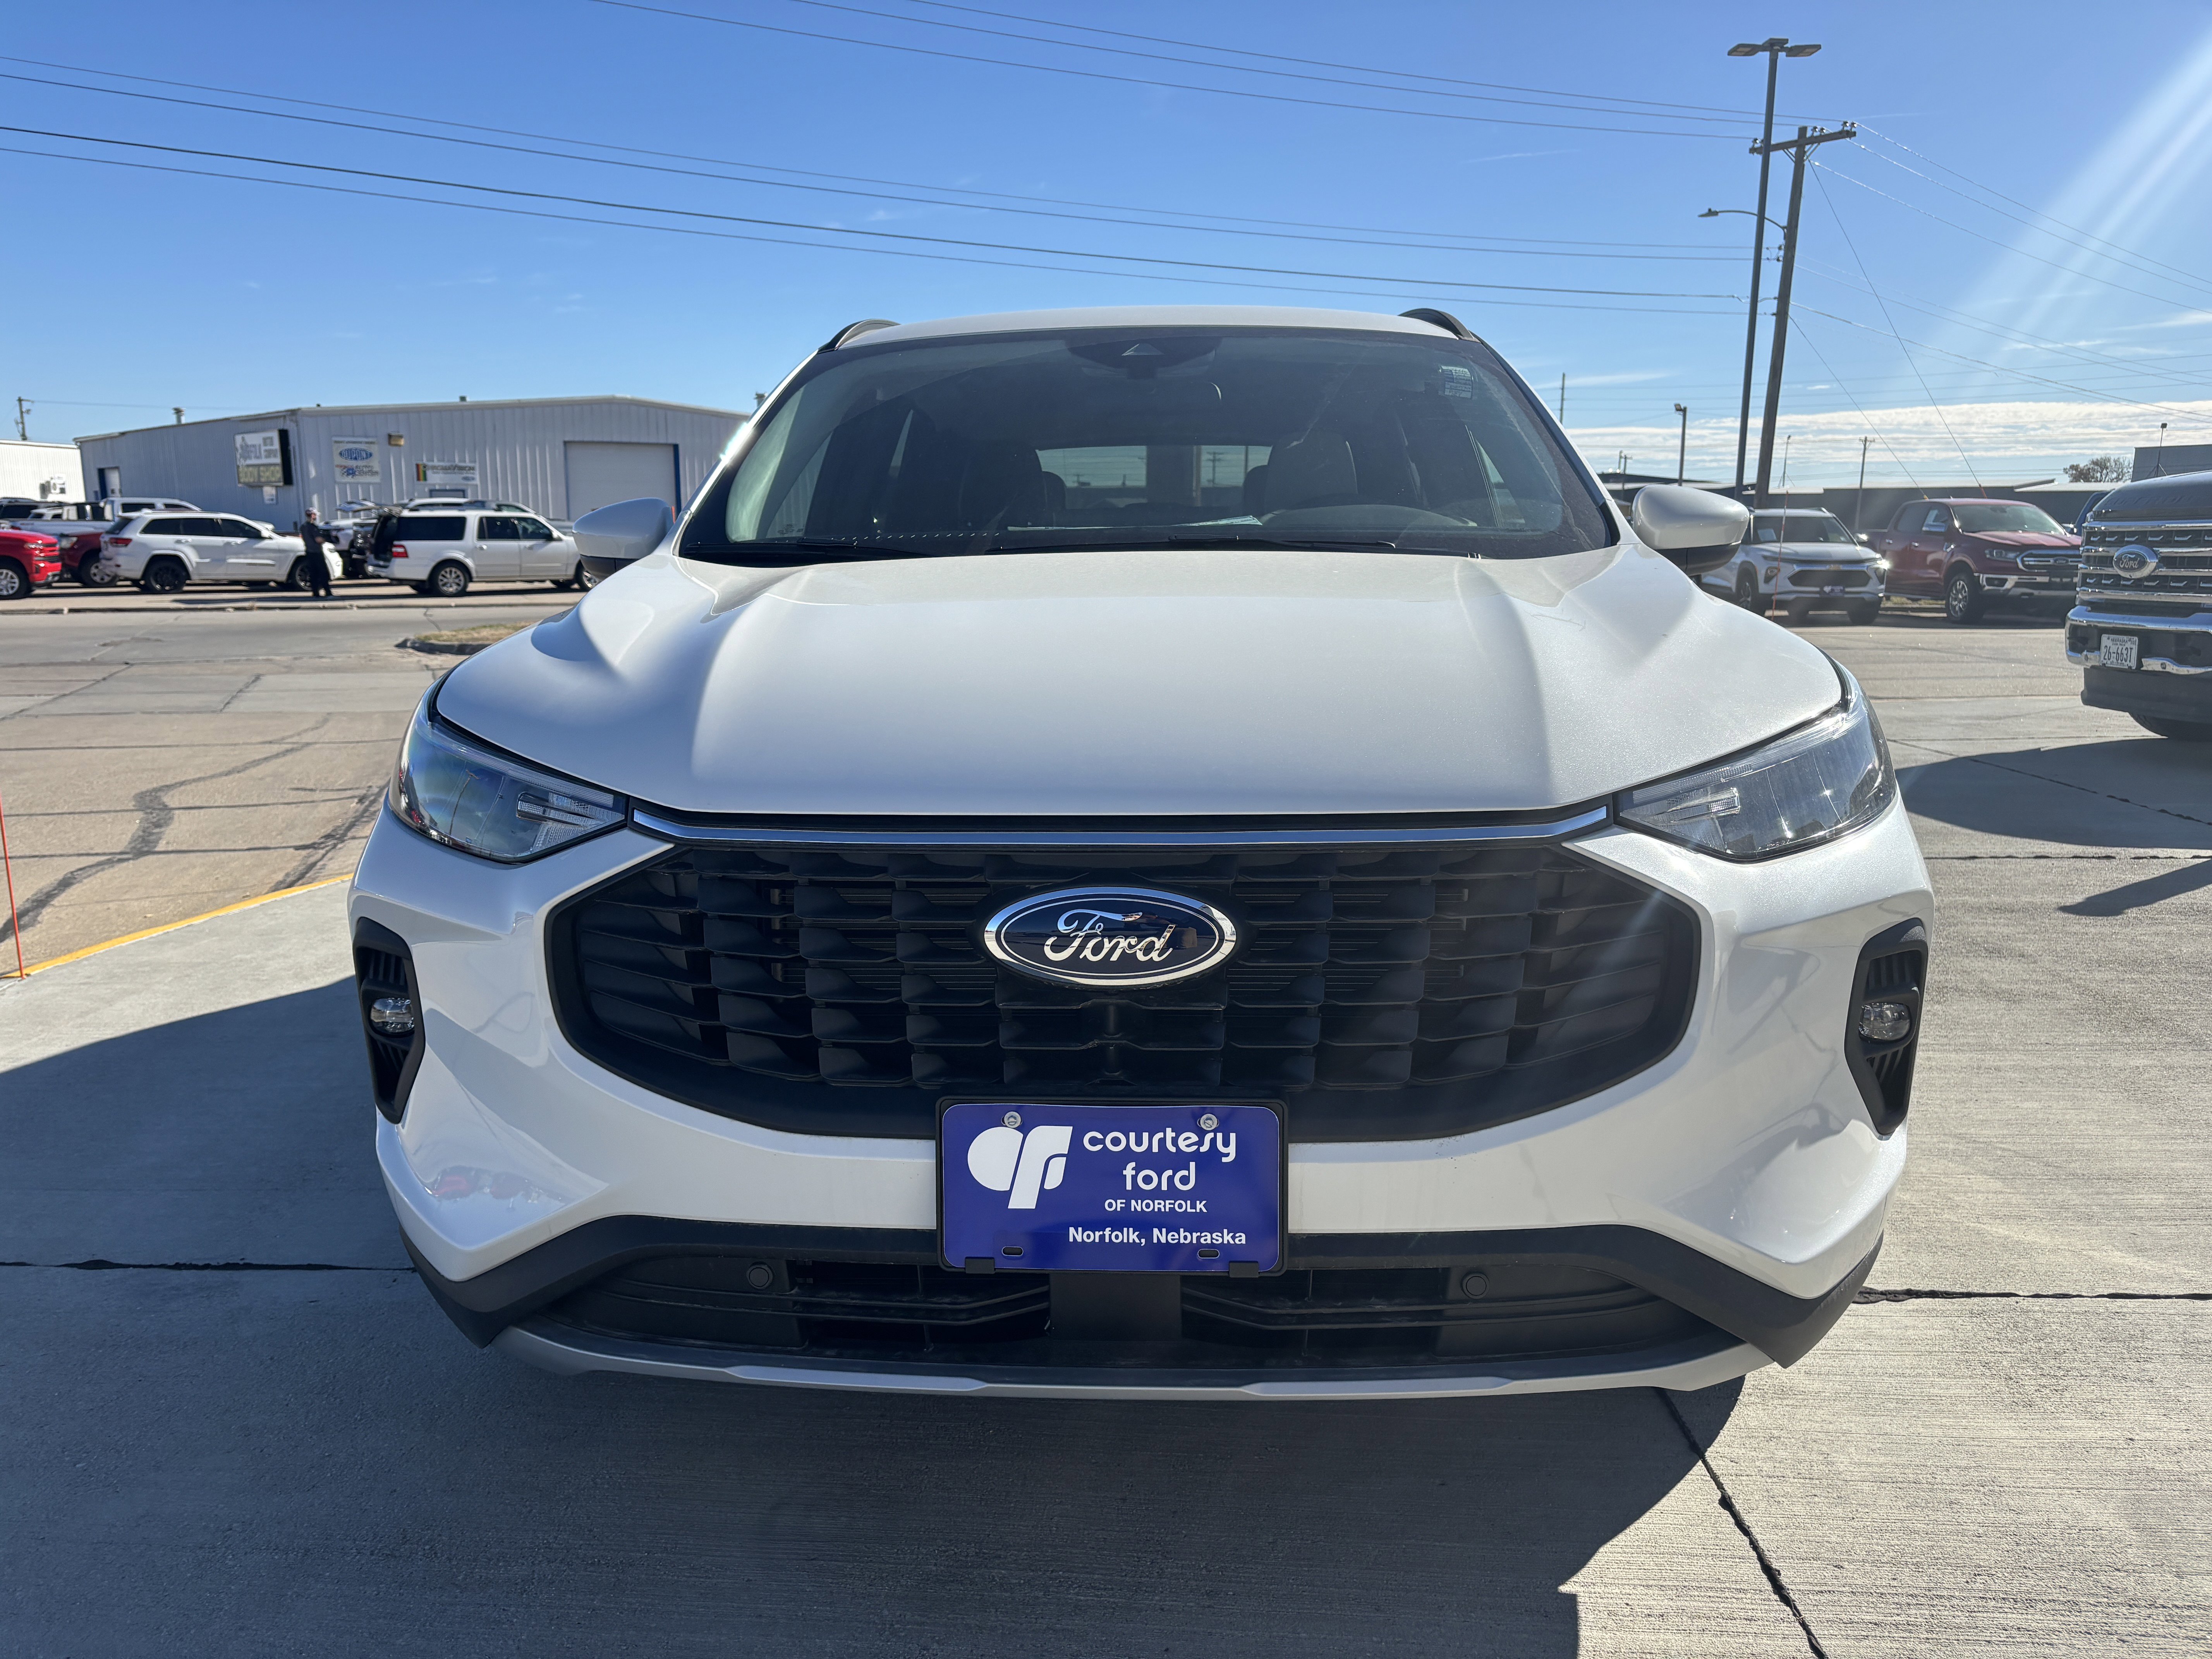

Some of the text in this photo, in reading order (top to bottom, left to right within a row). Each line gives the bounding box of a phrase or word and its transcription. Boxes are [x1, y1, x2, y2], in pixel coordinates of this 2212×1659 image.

[2119, 554, 2140, 568] Ford
[1044, 909, 1176, 962] Ford
[1084, 1127, 1235, 1163] courtesy
[1123, 1161, 1195, 1190] ford
[1105, 1199, 1207, 1212] OF NORFOLK
[1070, 1227, 1245, 1246] Norfolk, Nebraska
